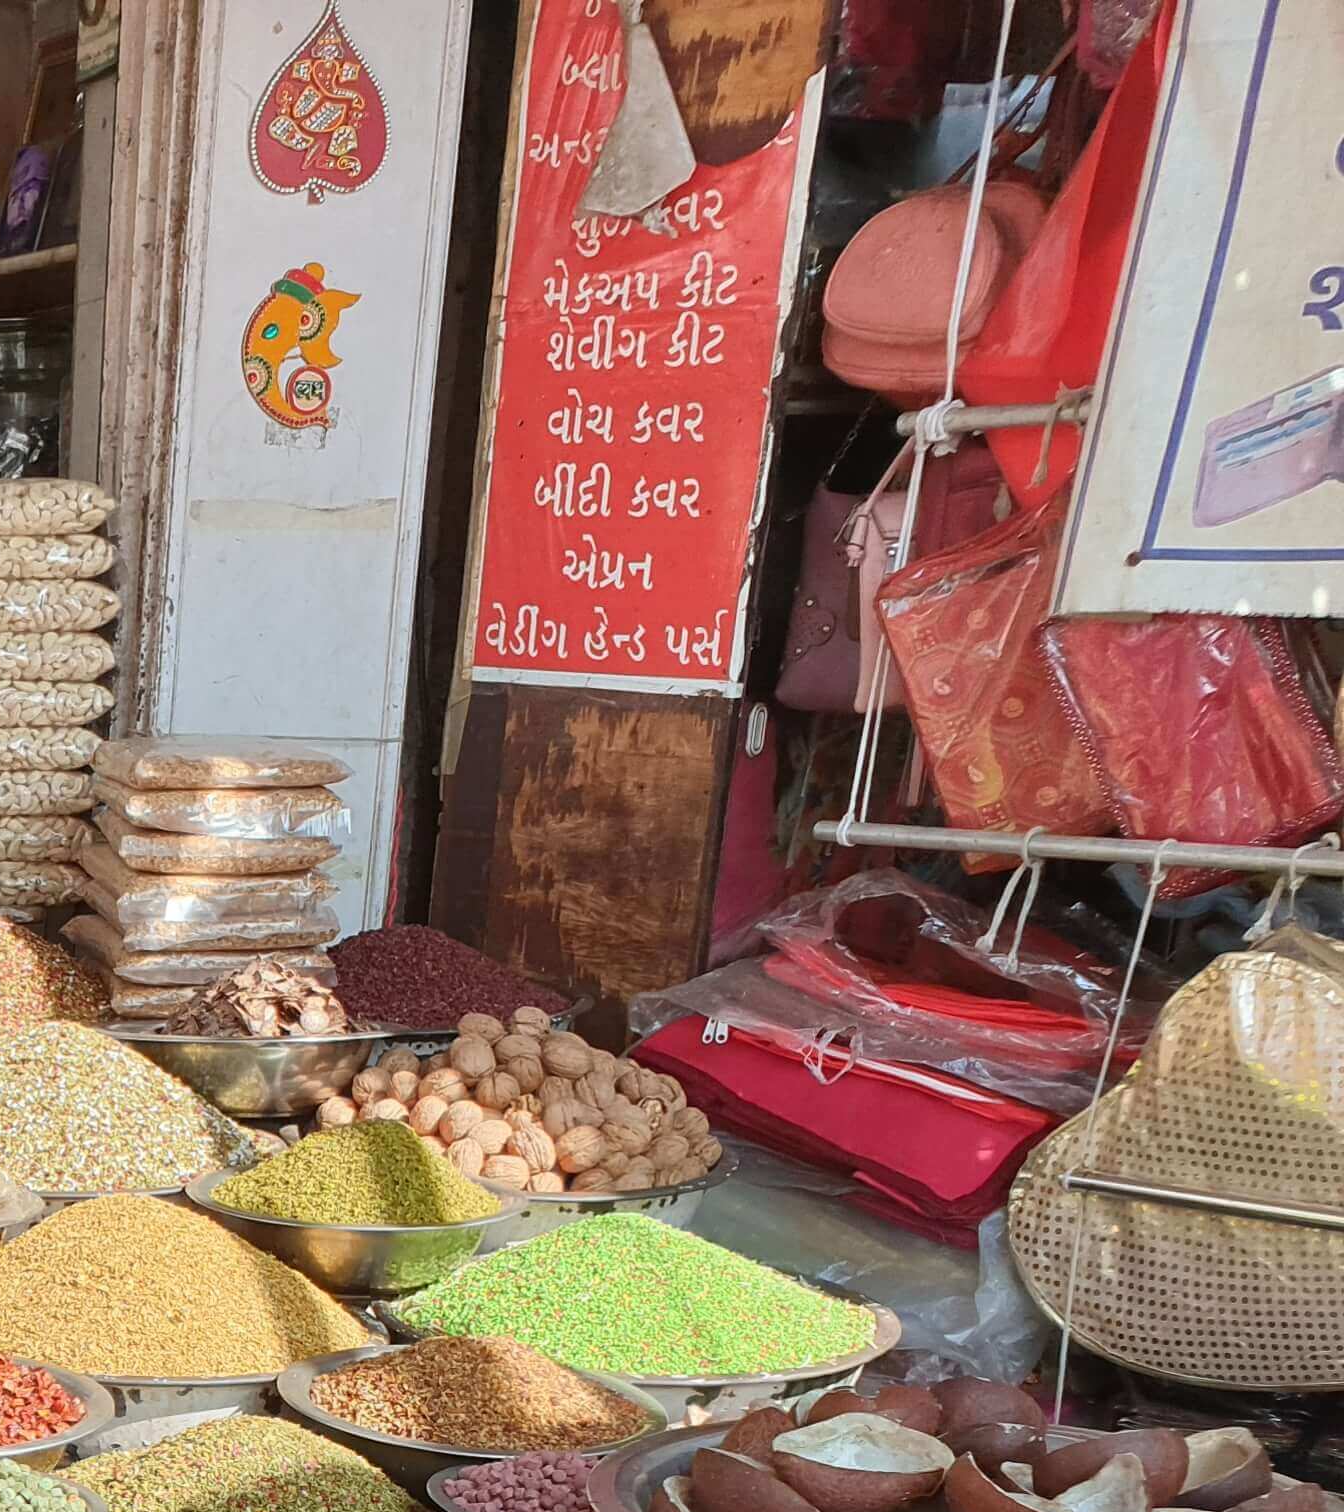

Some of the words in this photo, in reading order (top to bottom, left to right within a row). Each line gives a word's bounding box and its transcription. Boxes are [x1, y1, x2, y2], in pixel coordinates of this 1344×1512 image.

[543, 258, 660, 315] મેકઅપ
[676, 250, 738, 308] કીટ
[663, 311, 725, 368] કીટ
[547, 387, 614, 444] વોચ
[629, 400, 705, 443] કવર
[534, 462, 611, 517] બીંદી
[627, 475, 701, 517] કવર
[562, 533, 654, 590] એપ્રન
[485, 602, 568, 659] વેડીંગ
[584, 606, 647, 661] હેન્ડ
[665, 608, 729, 667] પર્સ
